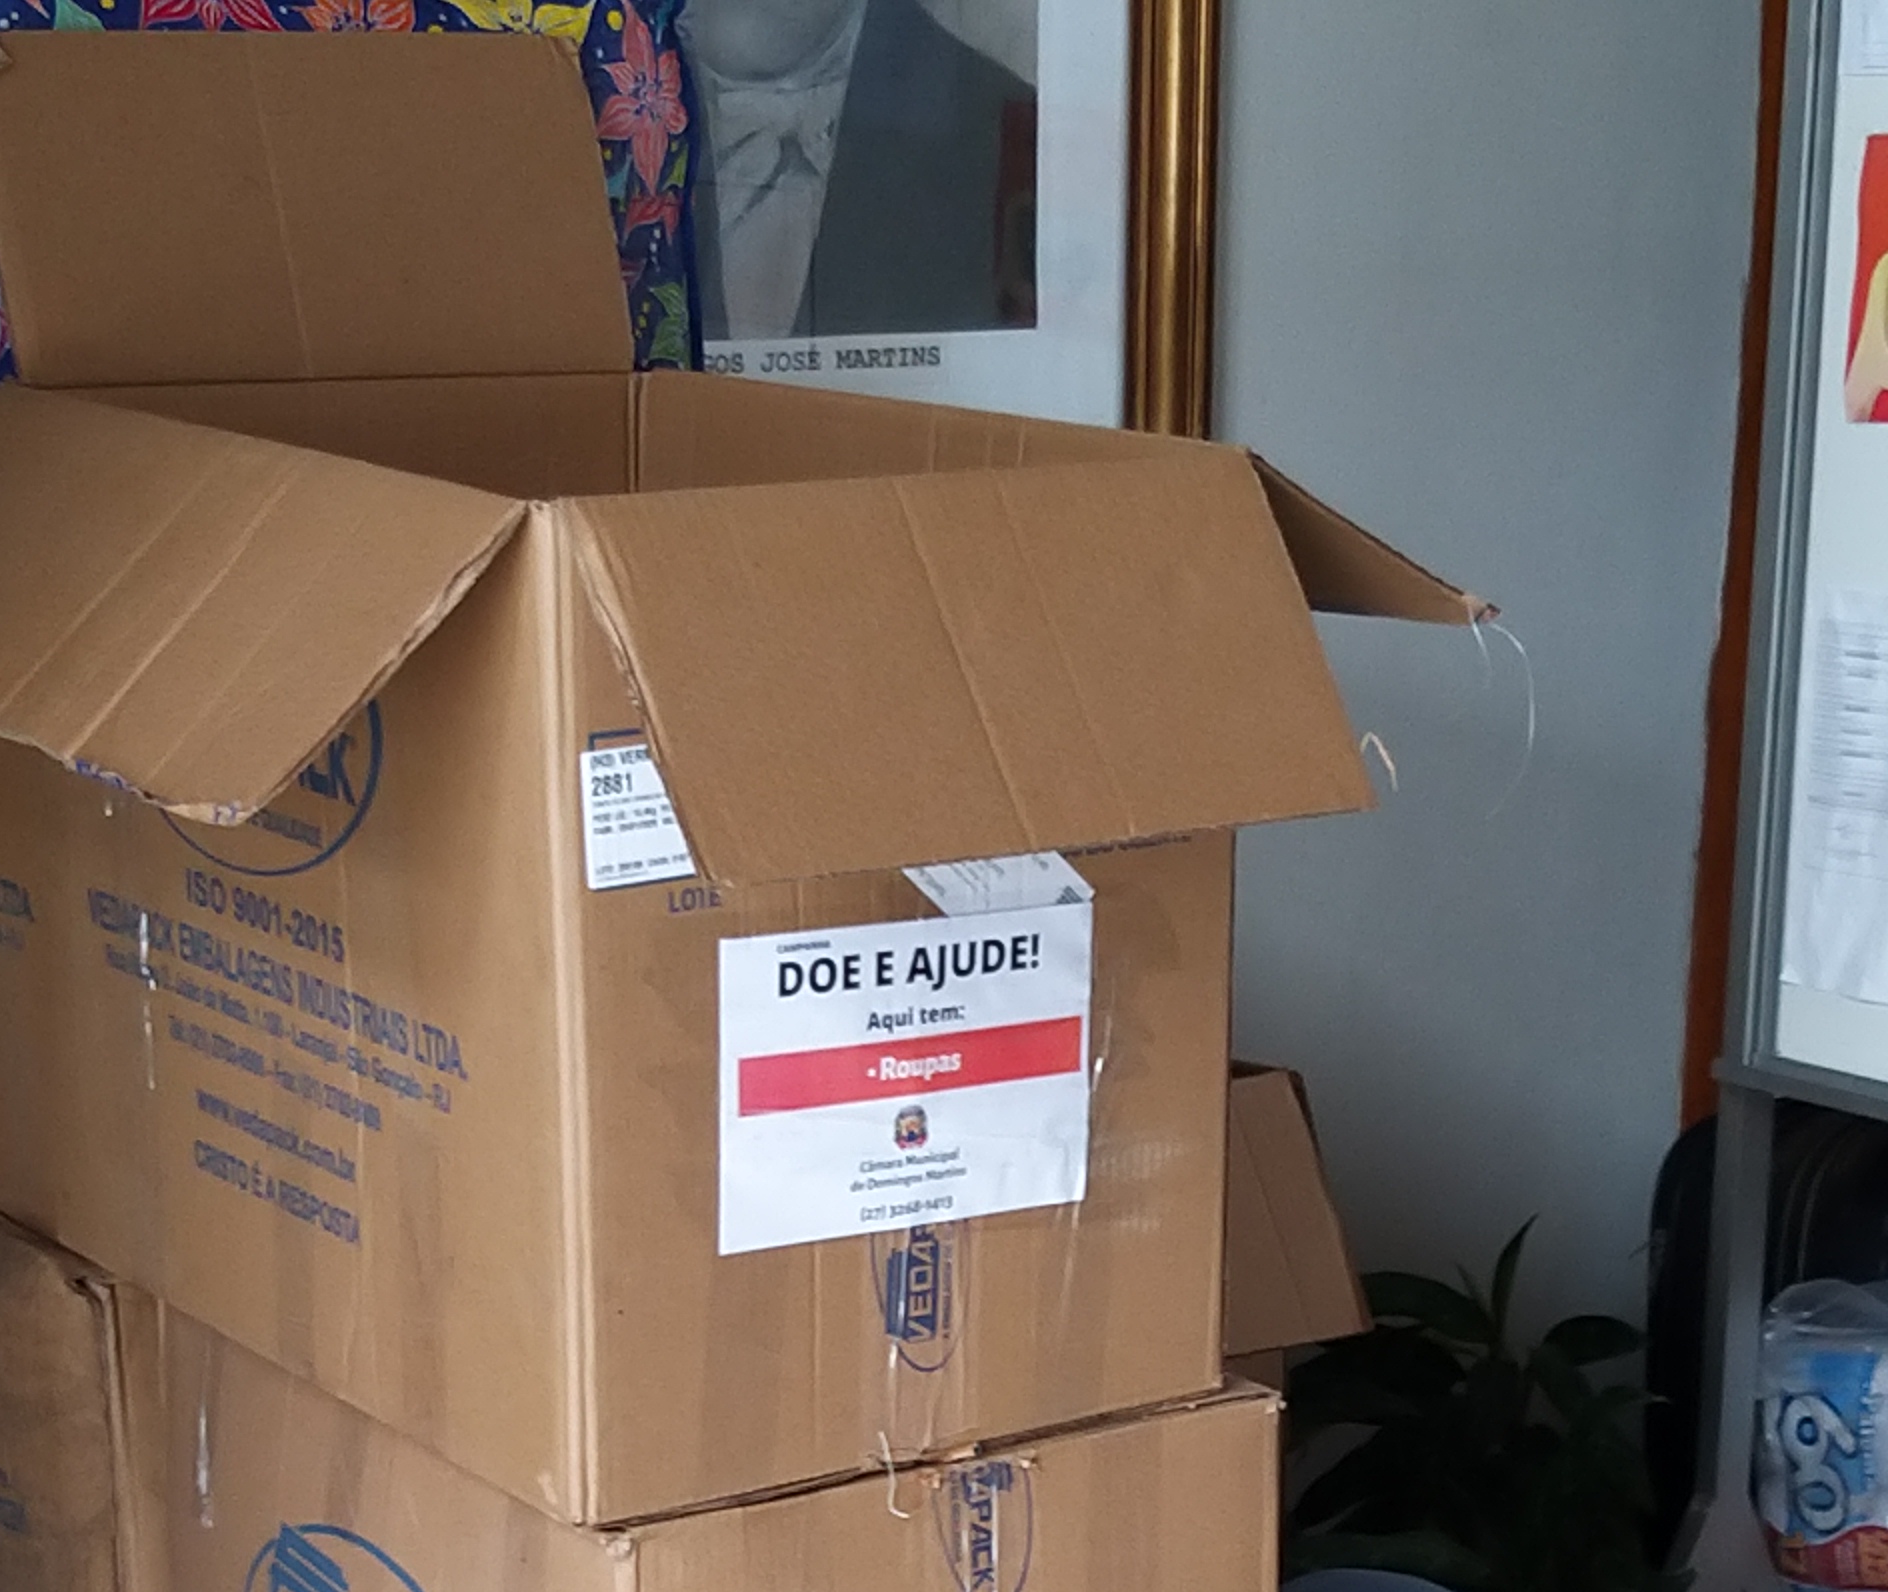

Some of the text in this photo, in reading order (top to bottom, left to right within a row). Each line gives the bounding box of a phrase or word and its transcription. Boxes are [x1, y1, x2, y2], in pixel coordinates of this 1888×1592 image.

[835, 345, 941, 370] MARTINS
[667, 886, 723, 914] LOTE
[185, 867, 345, 964] ISO 9001-2015
[778, 933, 1041, 997] DOE E AJUDE!
[179, 922, 293, 1007] EMBALAGENS
[298, 970, 409, 1056] INDUSTRIAIS
[866, 1004, 965, 1034] Aqui tem:
[859, 1147, 961, 1174] Câmara Municipal
[850, 1167, 968, 1192] de Domingos Martins
